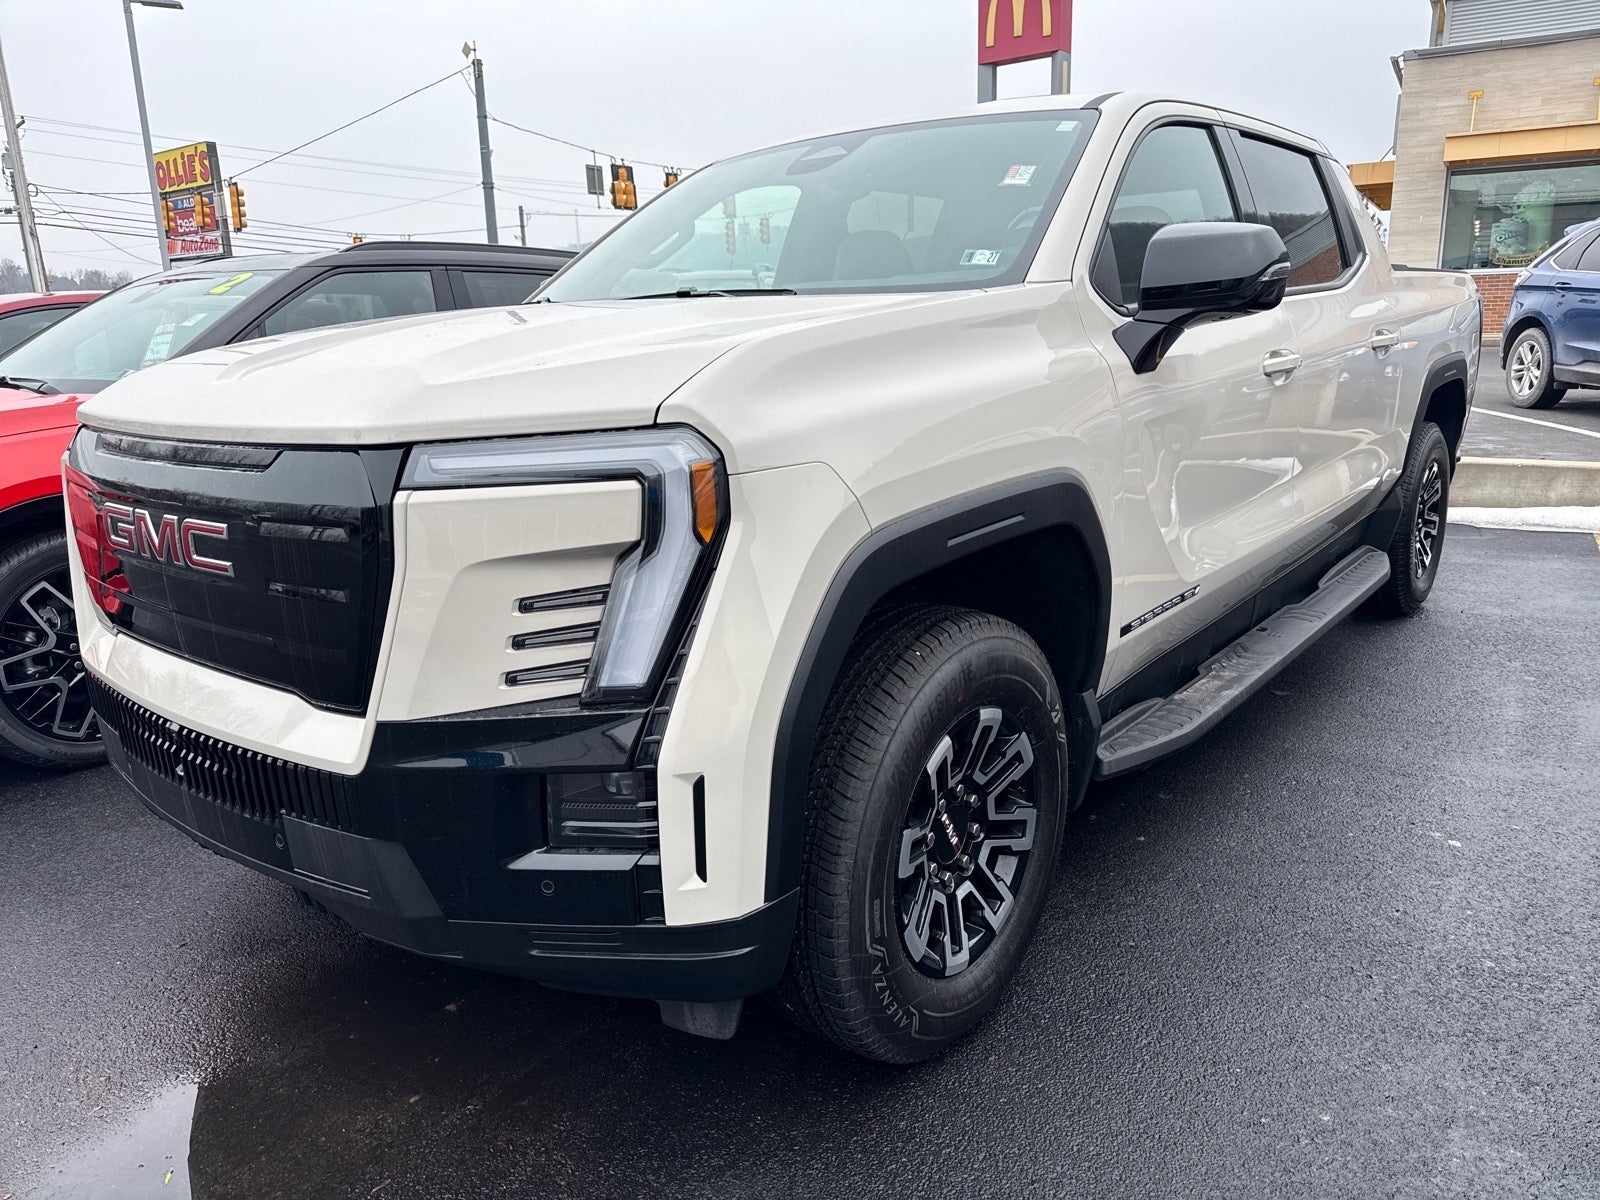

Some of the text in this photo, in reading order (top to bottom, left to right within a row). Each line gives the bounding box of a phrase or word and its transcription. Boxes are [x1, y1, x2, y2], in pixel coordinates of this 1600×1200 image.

[183, 198, 195, 209] ALD
[176, 213, 198, 233] beal
[181, 236, 219, 253] AutoZone
[102, 502, 235, 577] GMC
[872, 962, 911, 1028] ALENZA
